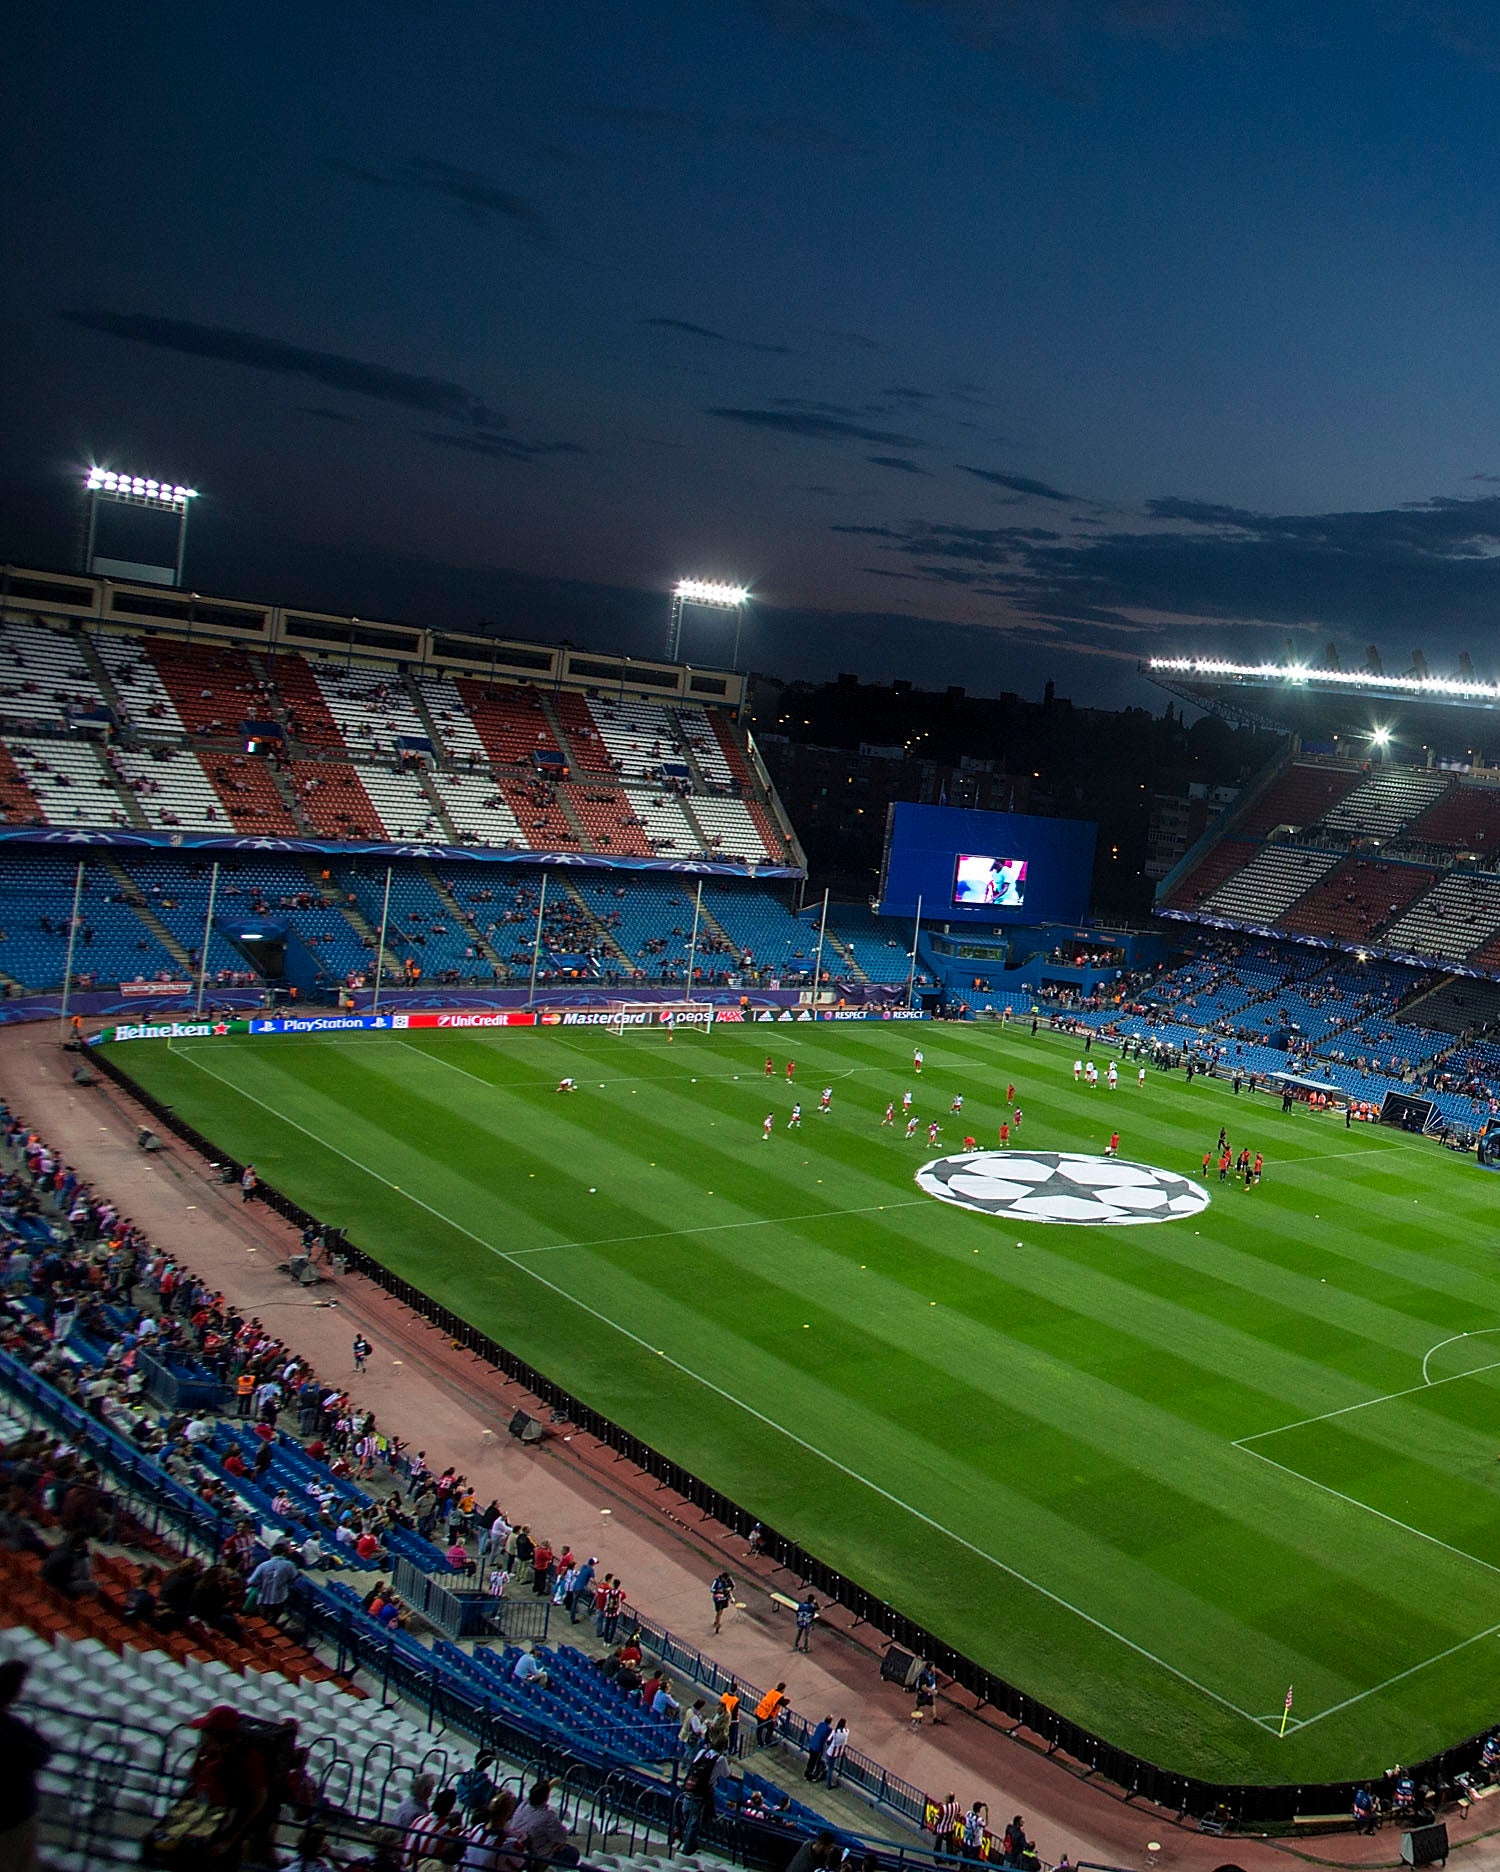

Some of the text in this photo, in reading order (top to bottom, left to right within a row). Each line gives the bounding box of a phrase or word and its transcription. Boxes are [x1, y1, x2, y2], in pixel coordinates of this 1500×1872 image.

[452, 1014, 508, 1026] UniCredit
[563, 1012, 645, 1025] MasterCard
[676, 1010, 747, 1023] pepsi MAX
[835, 1011, 868, 1019] RESPECT
[893, 1011, 924, 1019] RESPECT
[284, 1018, 363, 1031] PlayStation
[115, 1023, 211, 1041] Heineken
